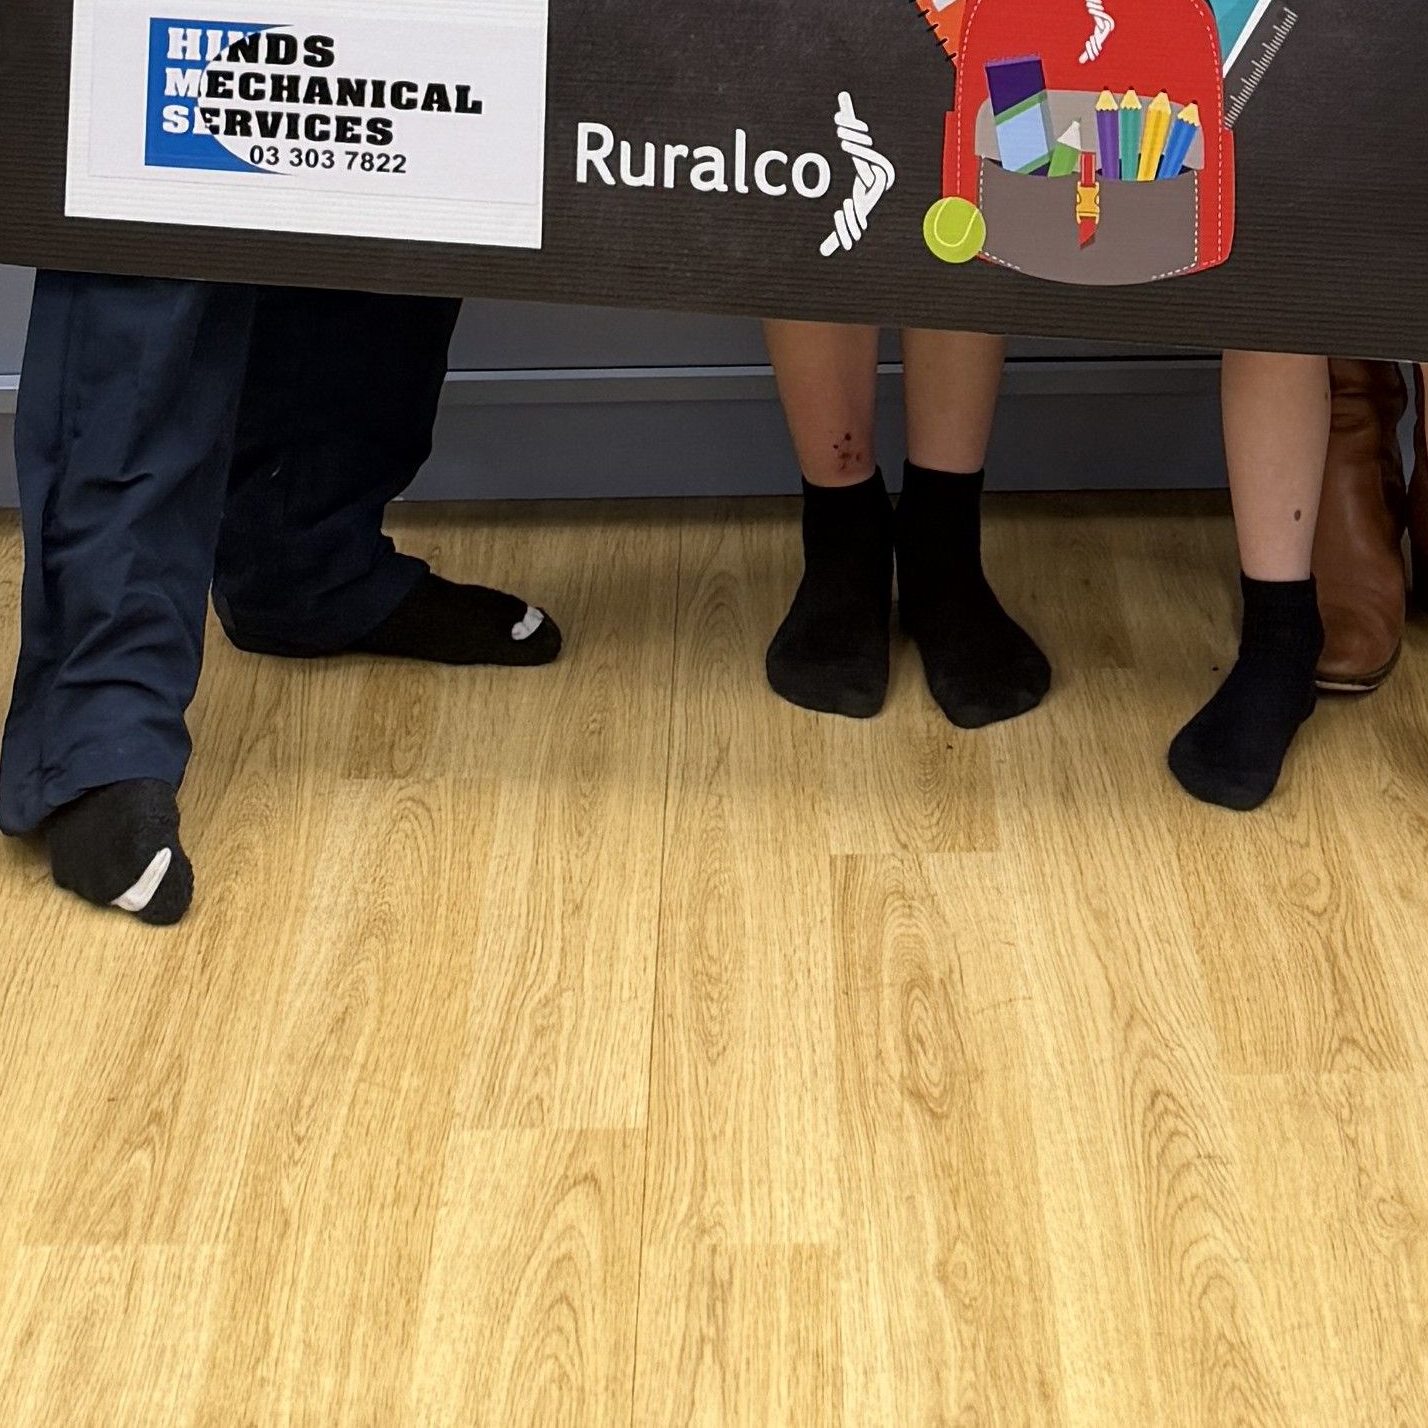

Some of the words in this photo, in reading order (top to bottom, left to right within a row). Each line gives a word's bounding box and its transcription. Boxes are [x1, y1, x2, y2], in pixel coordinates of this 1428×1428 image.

[166, 27, 335, 67] HINDS
[163, 68, 483, 114] MECHANICAL
[162, 104, 394, 146] SERVICES
[249, 146, 280, 166] 03
[288, 147, 336, 169] 303
[344, 150, 406, 174] 7822
[577, 123, 831, 199] Ruralco
